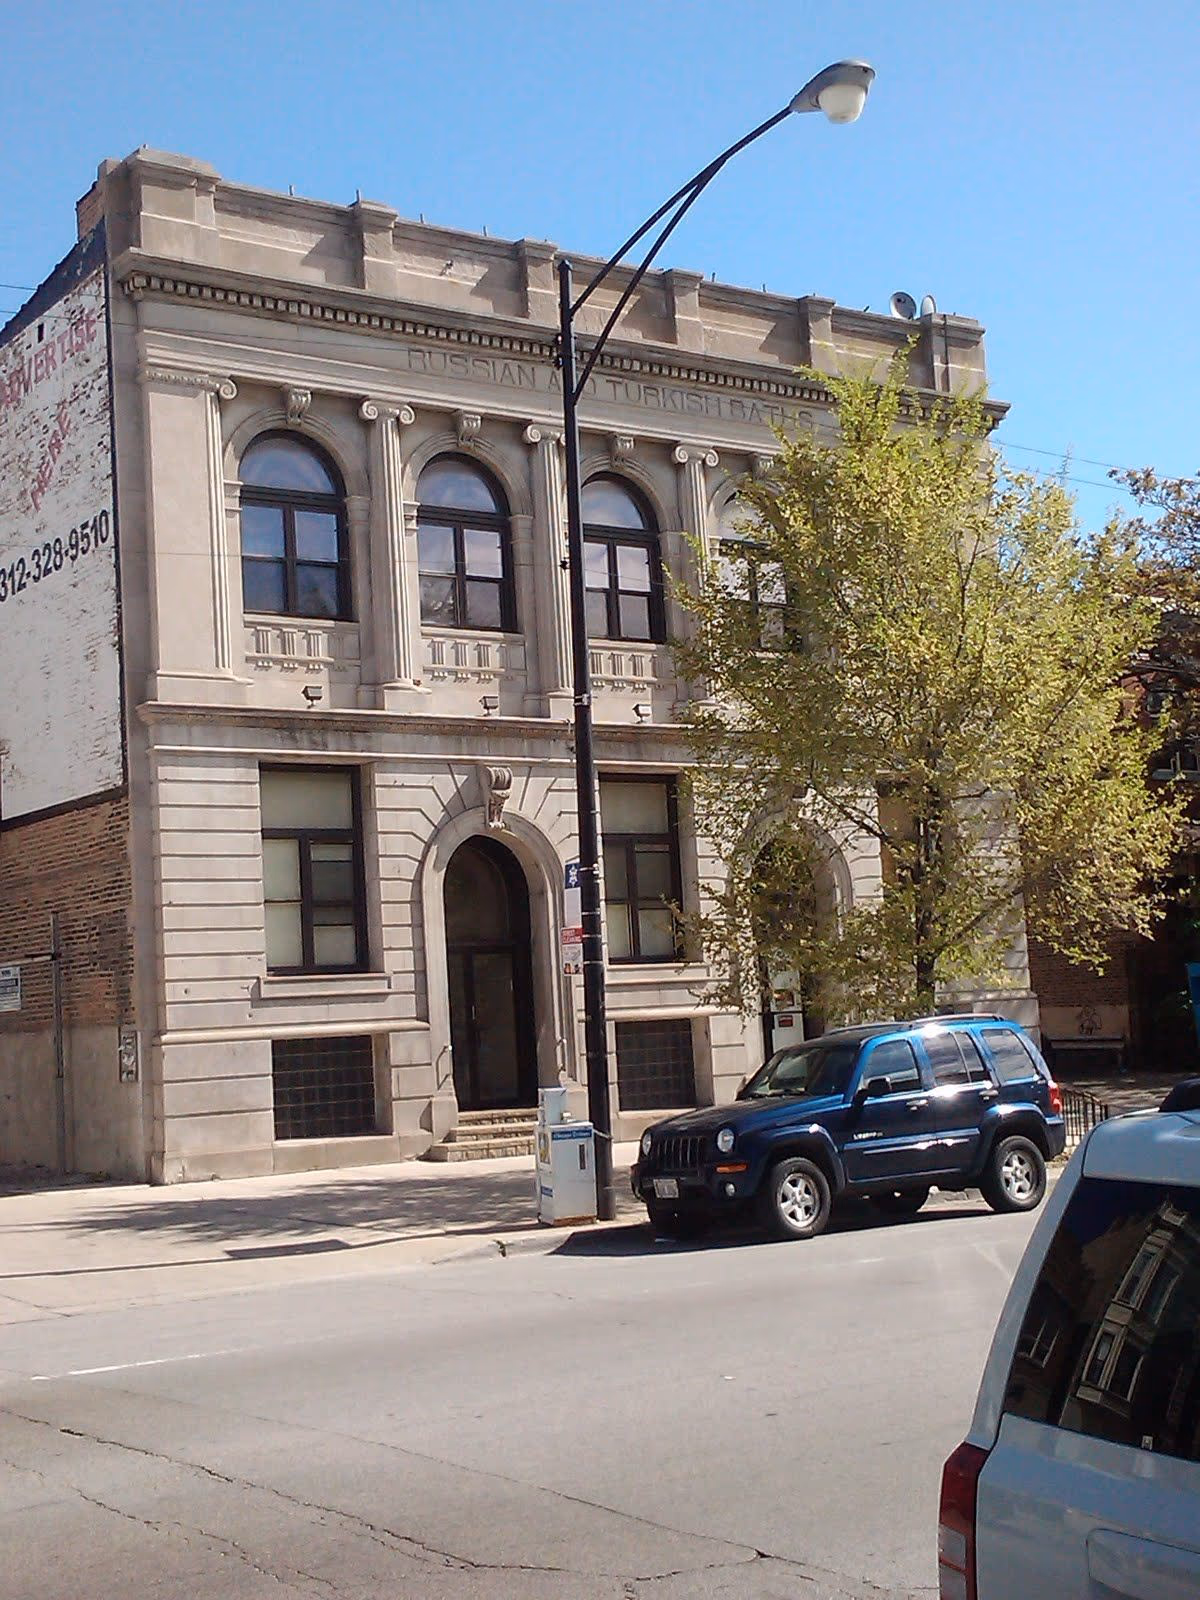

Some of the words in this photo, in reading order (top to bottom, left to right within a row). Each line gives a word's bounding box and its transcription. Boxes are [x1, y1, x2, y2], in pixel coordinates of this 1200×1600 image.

[407, 348, 536, 388] RUSSIAN
[549, 370, 596, 396] AD
[606, 379, 721, 416] TURKISH
[729, 399, 814, 428] BATHS
[0, 509, 109, 602] 312-328-9510
